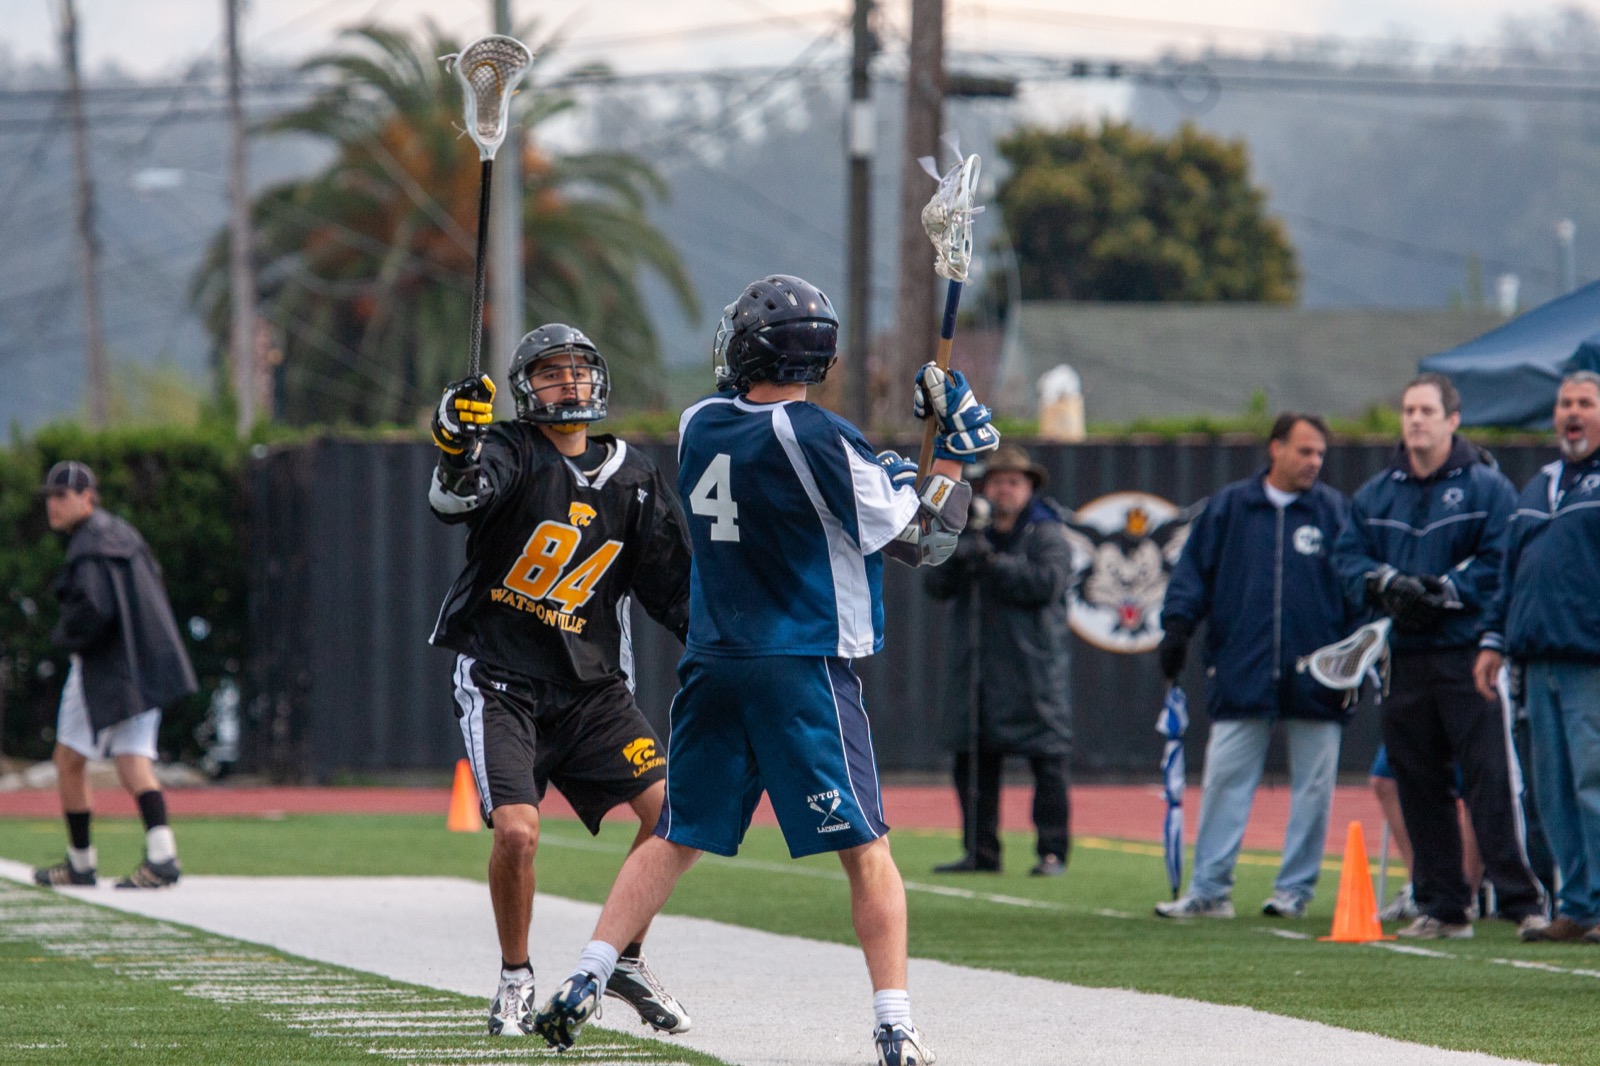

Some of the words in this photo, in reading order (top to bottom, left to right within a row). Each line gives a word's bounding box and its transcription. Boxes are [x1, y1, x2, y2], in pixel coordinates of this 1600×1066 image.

[689, 453, 740, 542] 4
[503, 519, 624, 614] 84
[490, 587, 588, 635] WATSONVILLE
[807, 789, 839, 803] APTOS
[817, 822, 850, 833] LACROSSE
